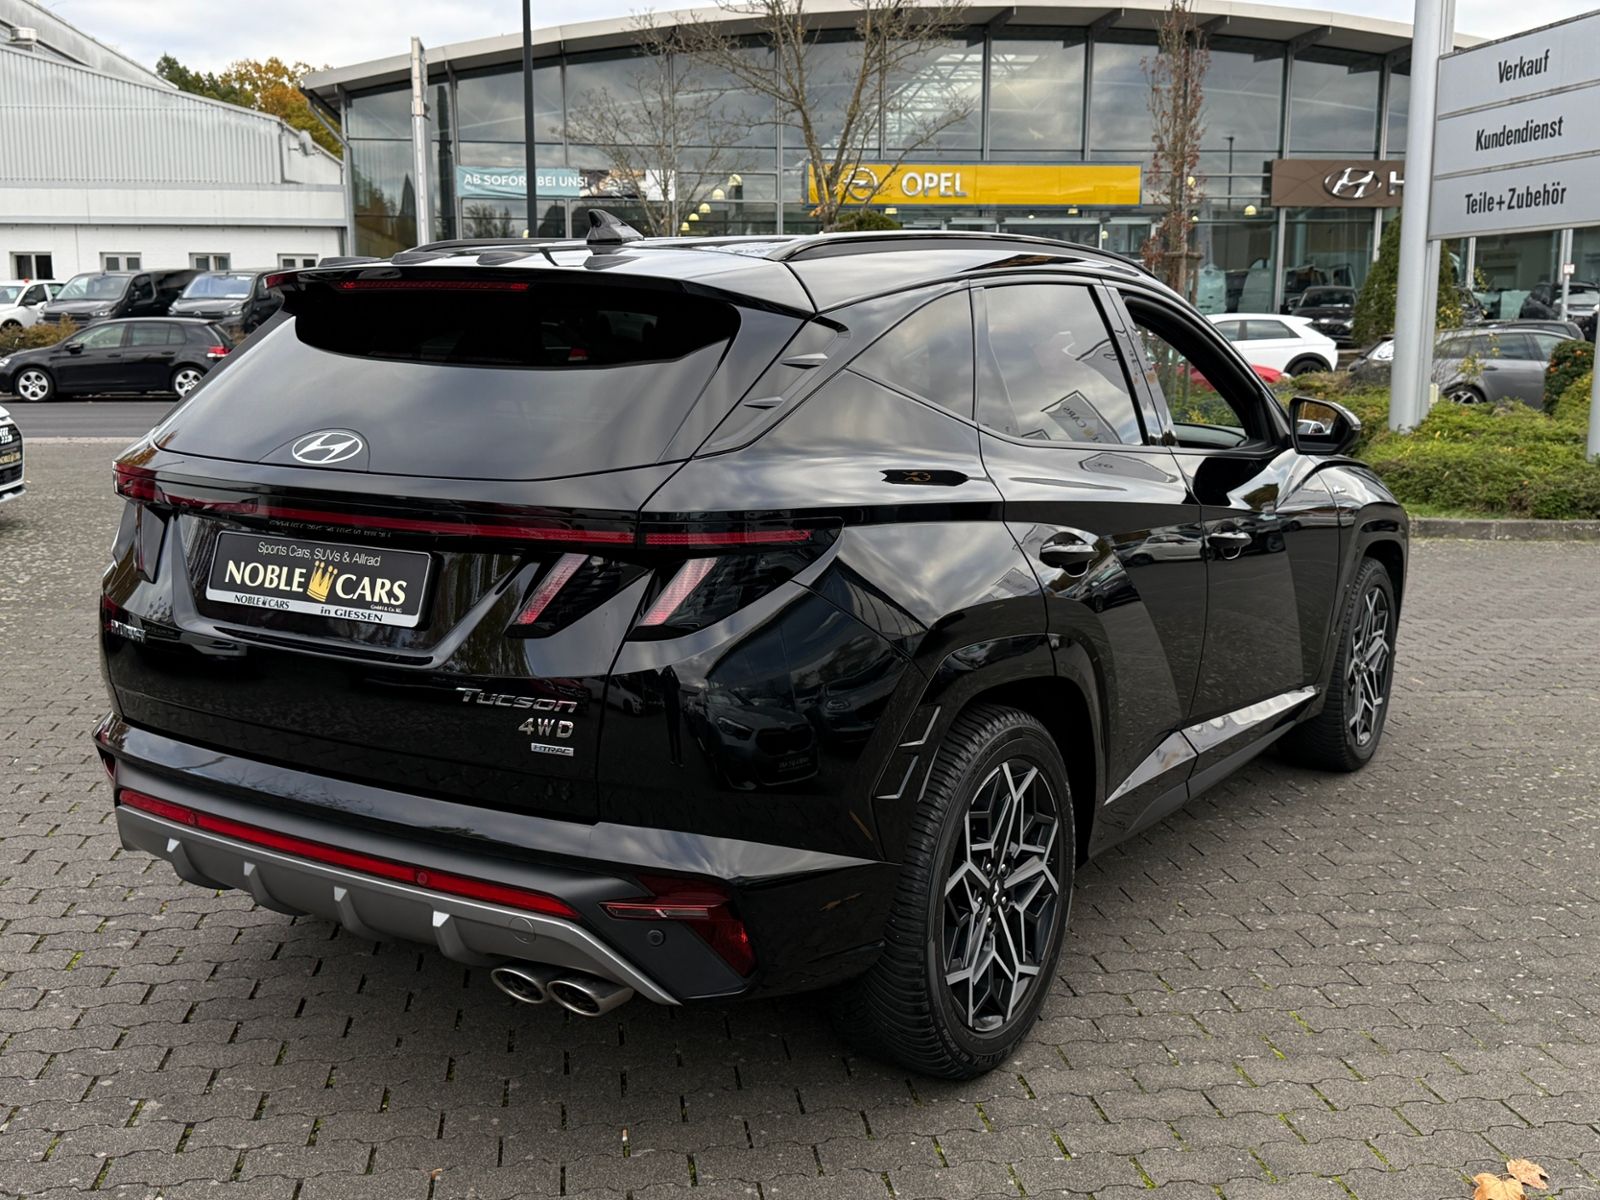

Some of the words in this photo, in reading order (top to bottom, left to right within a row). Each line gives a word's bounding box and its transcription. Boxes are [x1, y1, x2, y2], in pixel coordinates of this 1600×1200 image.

[1498, 49, 1550, 84] Verkauf
[1475, 115, 1564, 151] Kundendienst
[464, 174, 481, 185] AB
[483, 175, 527, 187] SOFOR
[537, 176, 556, 187] BEI
[559, 176, 588, 188] UNS!
[901, 172, 968, 197] OPEL
[1465, 181, 1567, 215] Teile+Zubehör
[257, 541, 287, 556] Sports
[288, 544, 312, 559] Cars,
[313, 547, 340, 562] SUVs
[342, 551, 351, 563] &
[351, 552, 381, 567] Allrad
[224, 559, 307, 593] NOBLE
[335, 573, 408, 606] CARS
[234, 594, 262, 606] NOBLE
[268, 598, 290, 610] CARS
[320, 606, 331, 615] in
[334, 608, 383, 622] GIESSEN
[518, 717, 574, 738] 4WD
